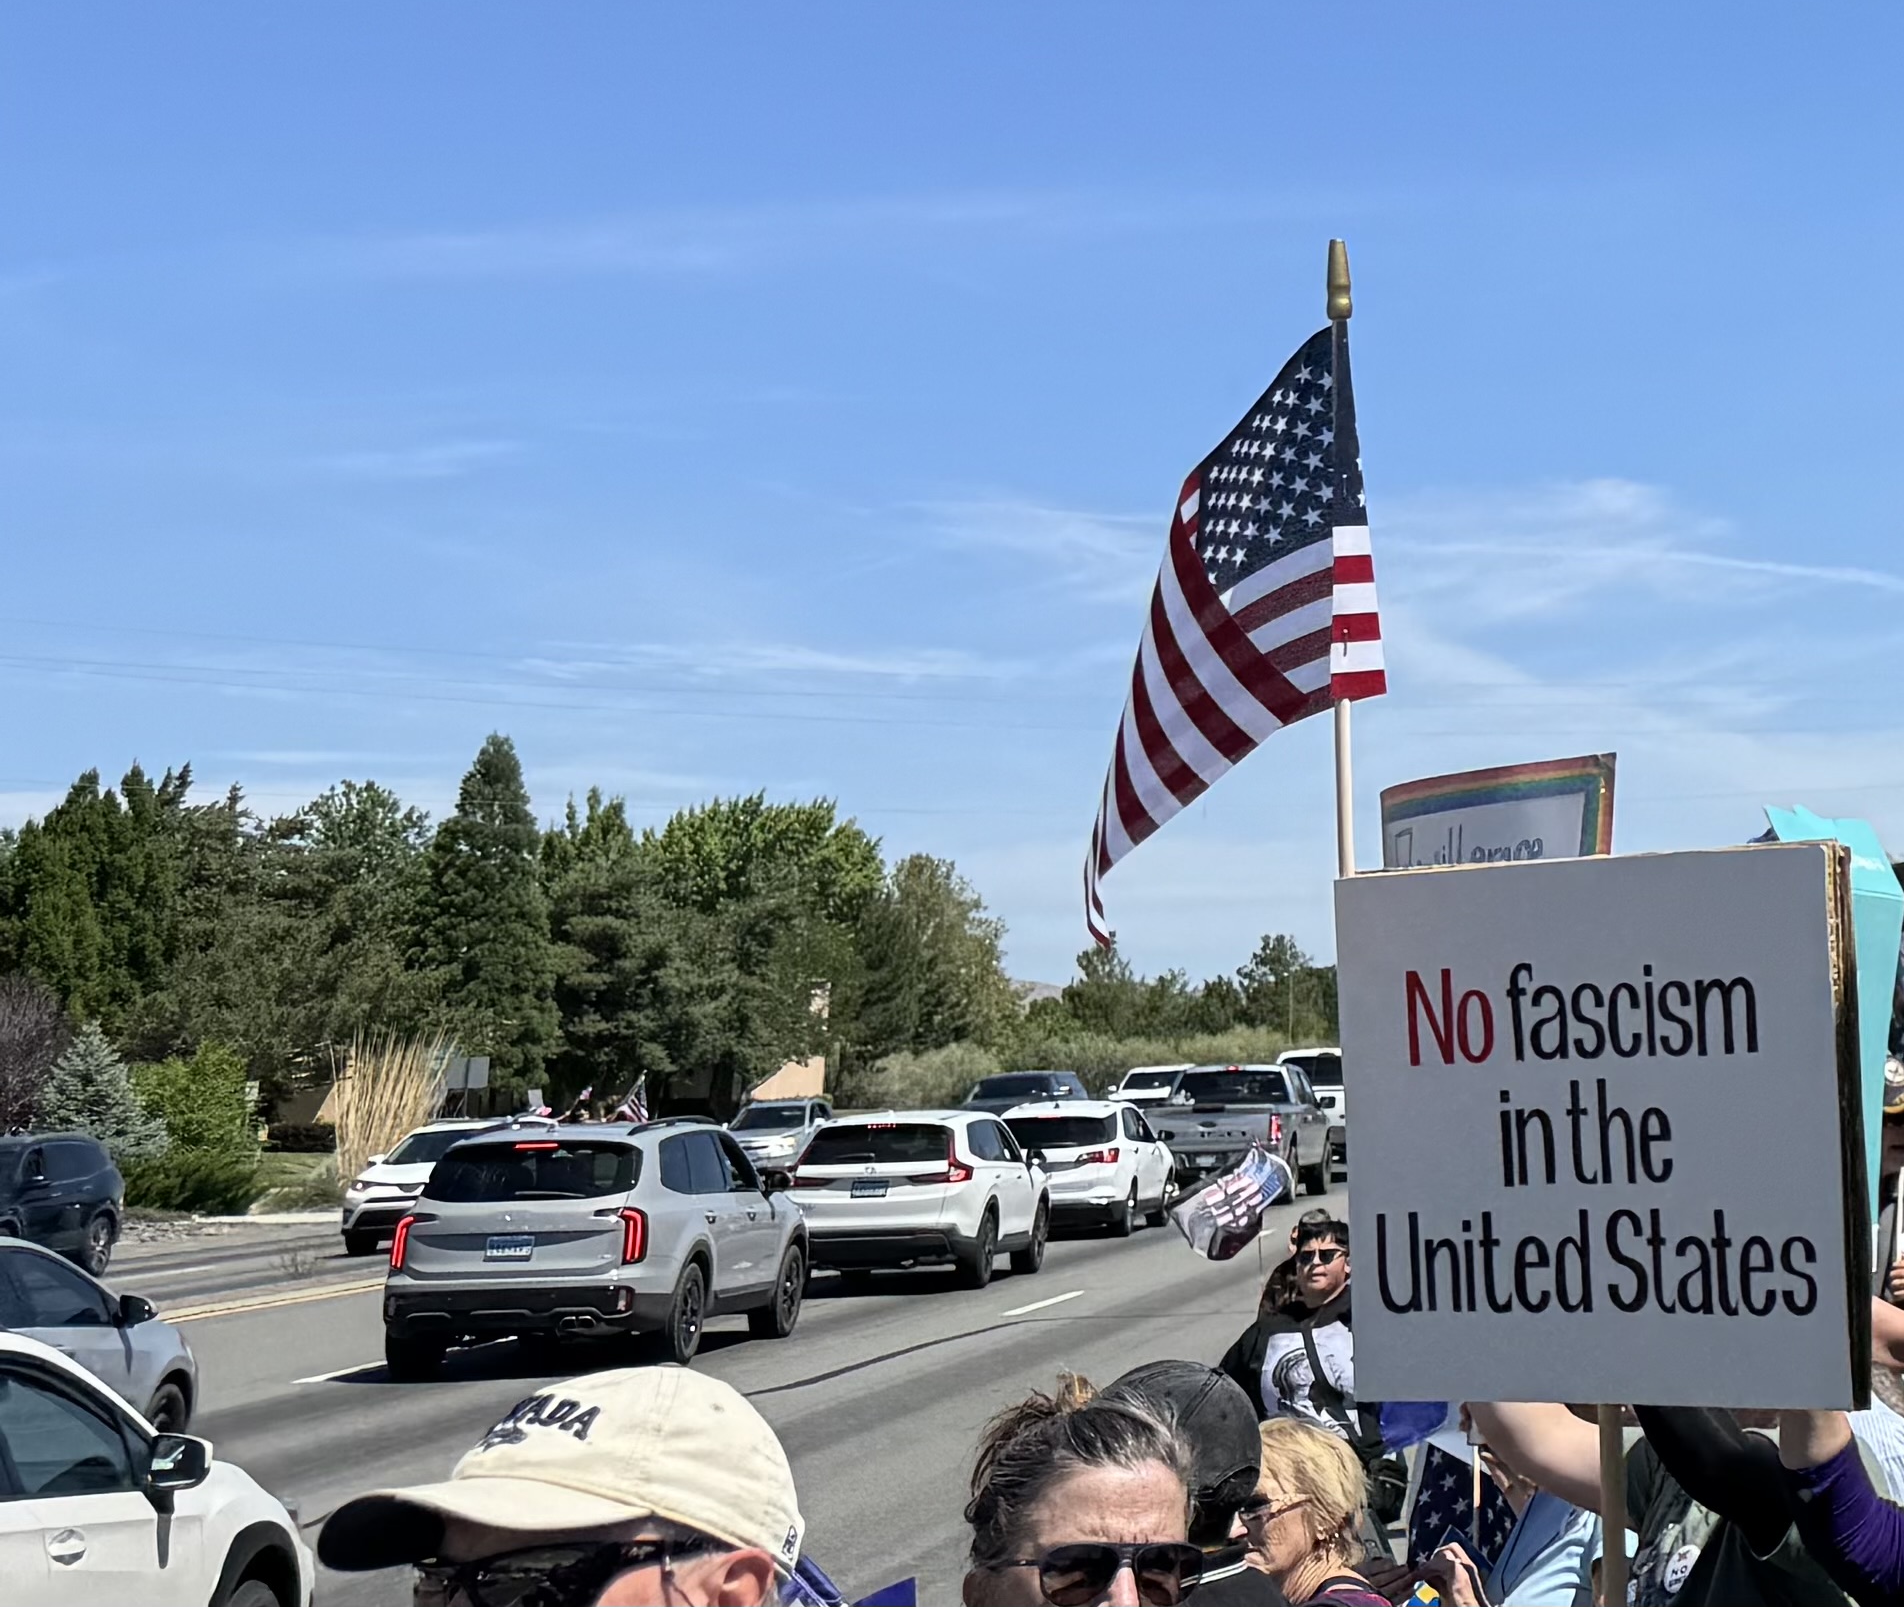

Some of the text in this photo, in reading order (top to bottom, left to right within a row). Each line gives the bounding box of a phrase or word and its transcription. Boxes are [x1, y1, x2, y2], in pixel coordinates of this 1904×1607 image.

[1405, 962, 1759, 1067] No fascism
[1499, 1078, 1674, 1188] in the
[1376, 1207, 1818, 1317] United States
